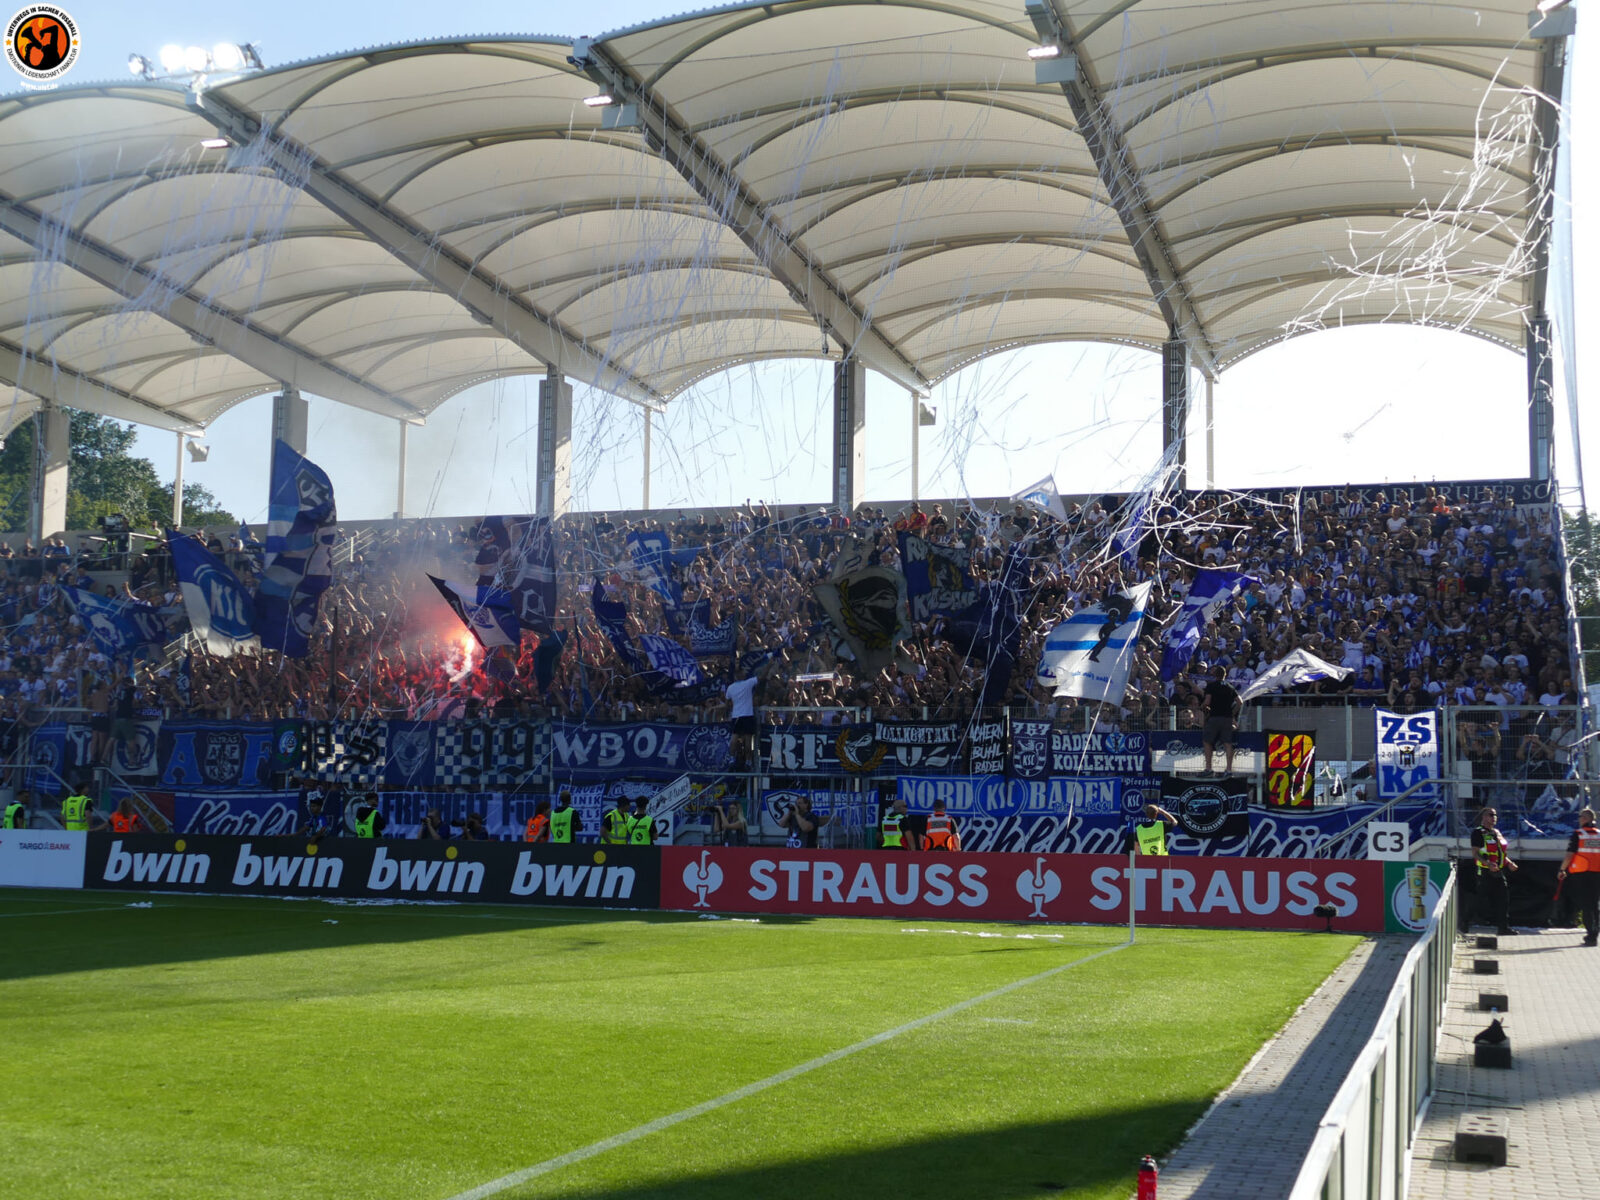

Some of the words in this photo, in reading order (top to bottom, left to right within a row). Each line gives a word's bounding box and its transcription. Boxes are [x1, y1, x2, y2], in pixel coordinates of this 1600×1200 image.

[209, 735, 239, 745] ULTRAS
[1052, 734, 1103, 752] BADEN
[1381, 715, 1432, 745] ZS
[769, 733, 828, 770] RF
[1127, 738, 1142, 754] KSC
[974, 759, 1004, 773] BADEN
[1052, 753, 1146, 772] KOLLEKTIV
[1381, 764, 1435, 794] KA
[902, 780, 974, 811] NORD
[986, 782, 1016, 812] KSC
[1028, 781, 1115, 812] BADEN
[1127, 794, 1141, 808] KSC
[1182, 814, 1227, 832] KARLSRUHE
[1372, 831, 1404, 853] C3
[103, 839, 211, 884] bwin
[232, 843, 344, 888] bwin
[367, 846, 486, 894] bwin
[509, 850, 636, 900] bwin
[748, 859, 989, 908] STRAUSS
[1089, 866, 1359, 918] STRAUSS
